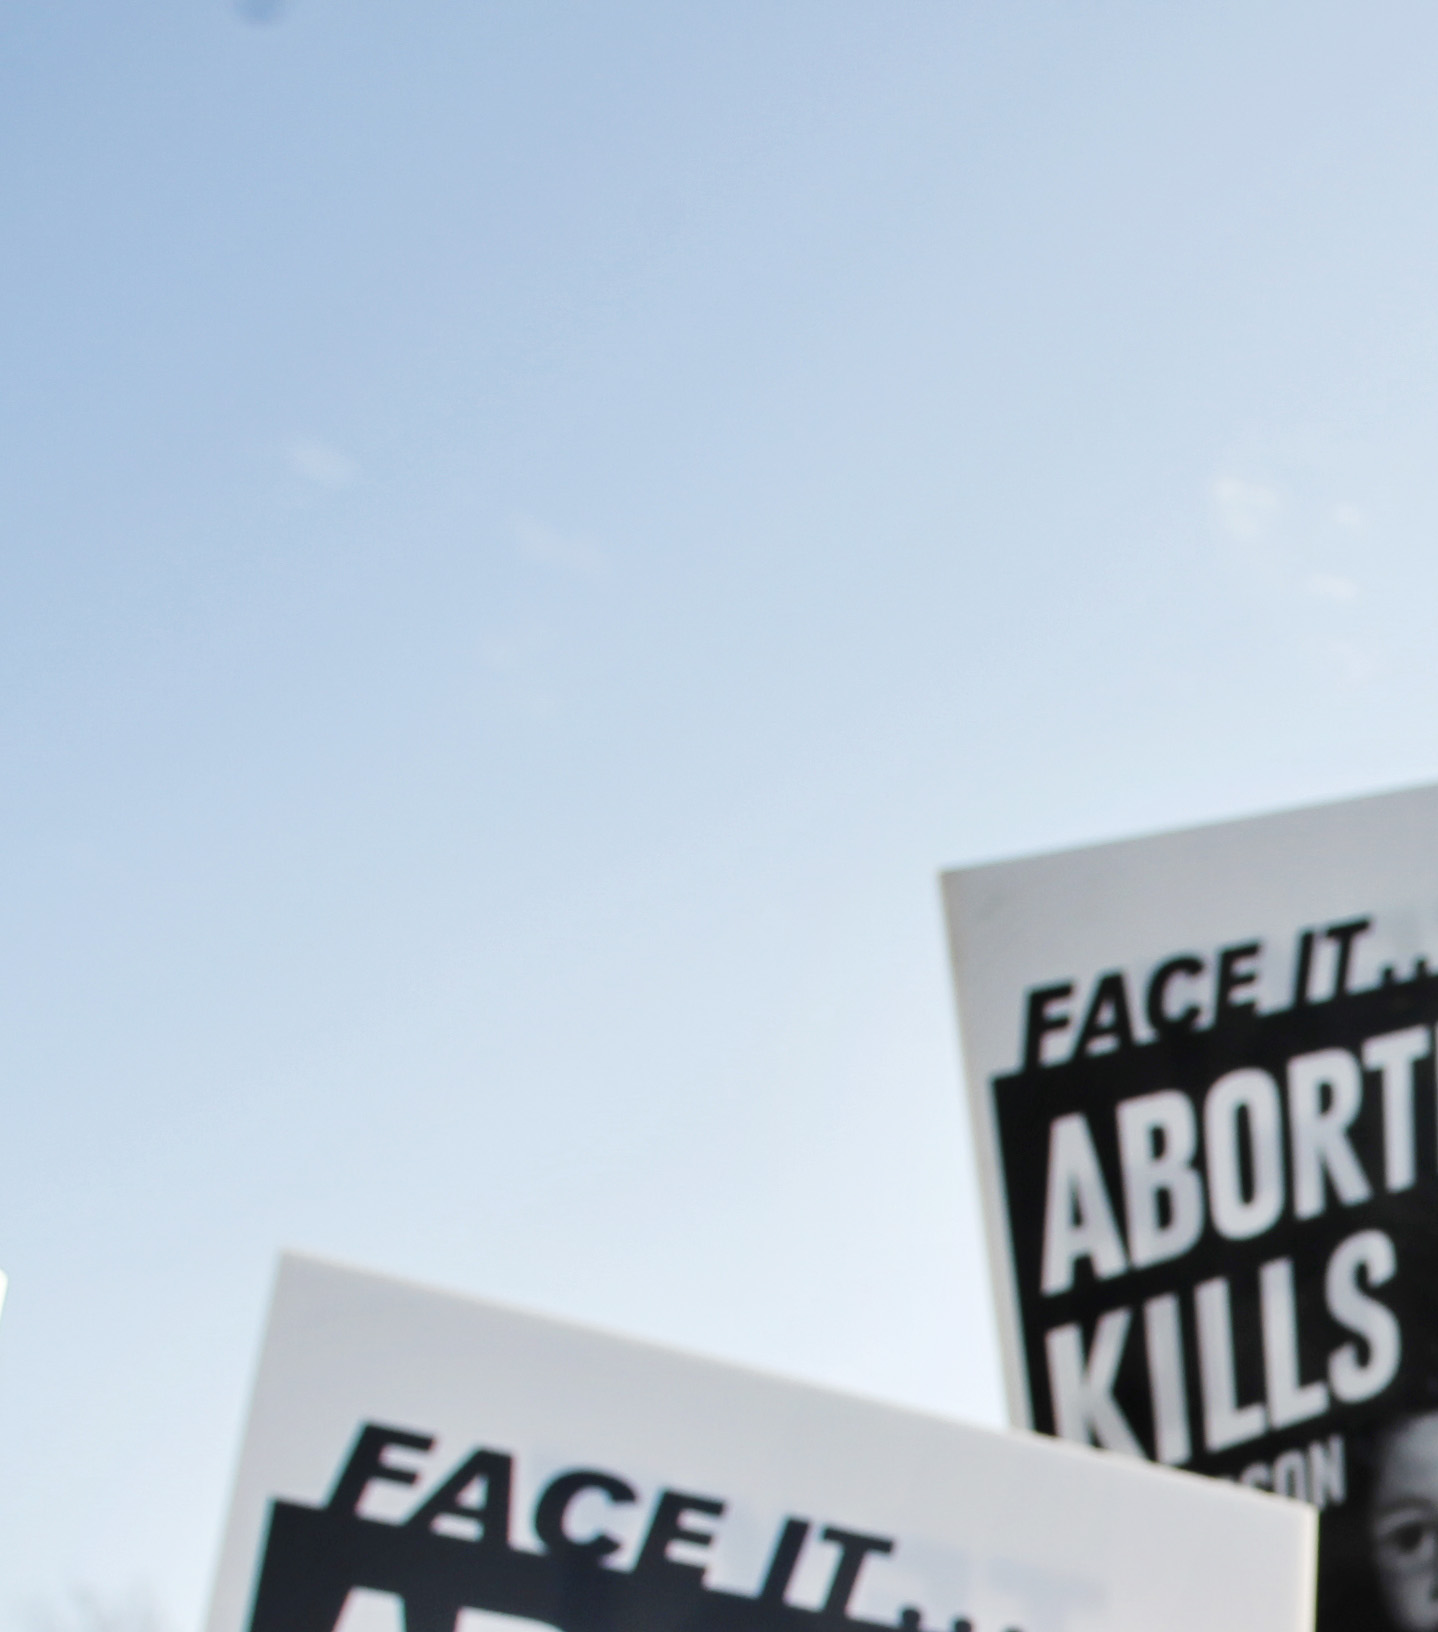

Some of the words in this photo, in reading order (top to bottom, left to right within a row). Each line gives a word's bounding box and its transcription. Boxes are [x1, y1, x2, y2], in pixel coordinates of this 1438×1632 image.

[1020, 935, 1266, 1070] FACE
[1046, 1228, 1402, 1466] KILLS
[322, 1420, 732, 1595] FACE
